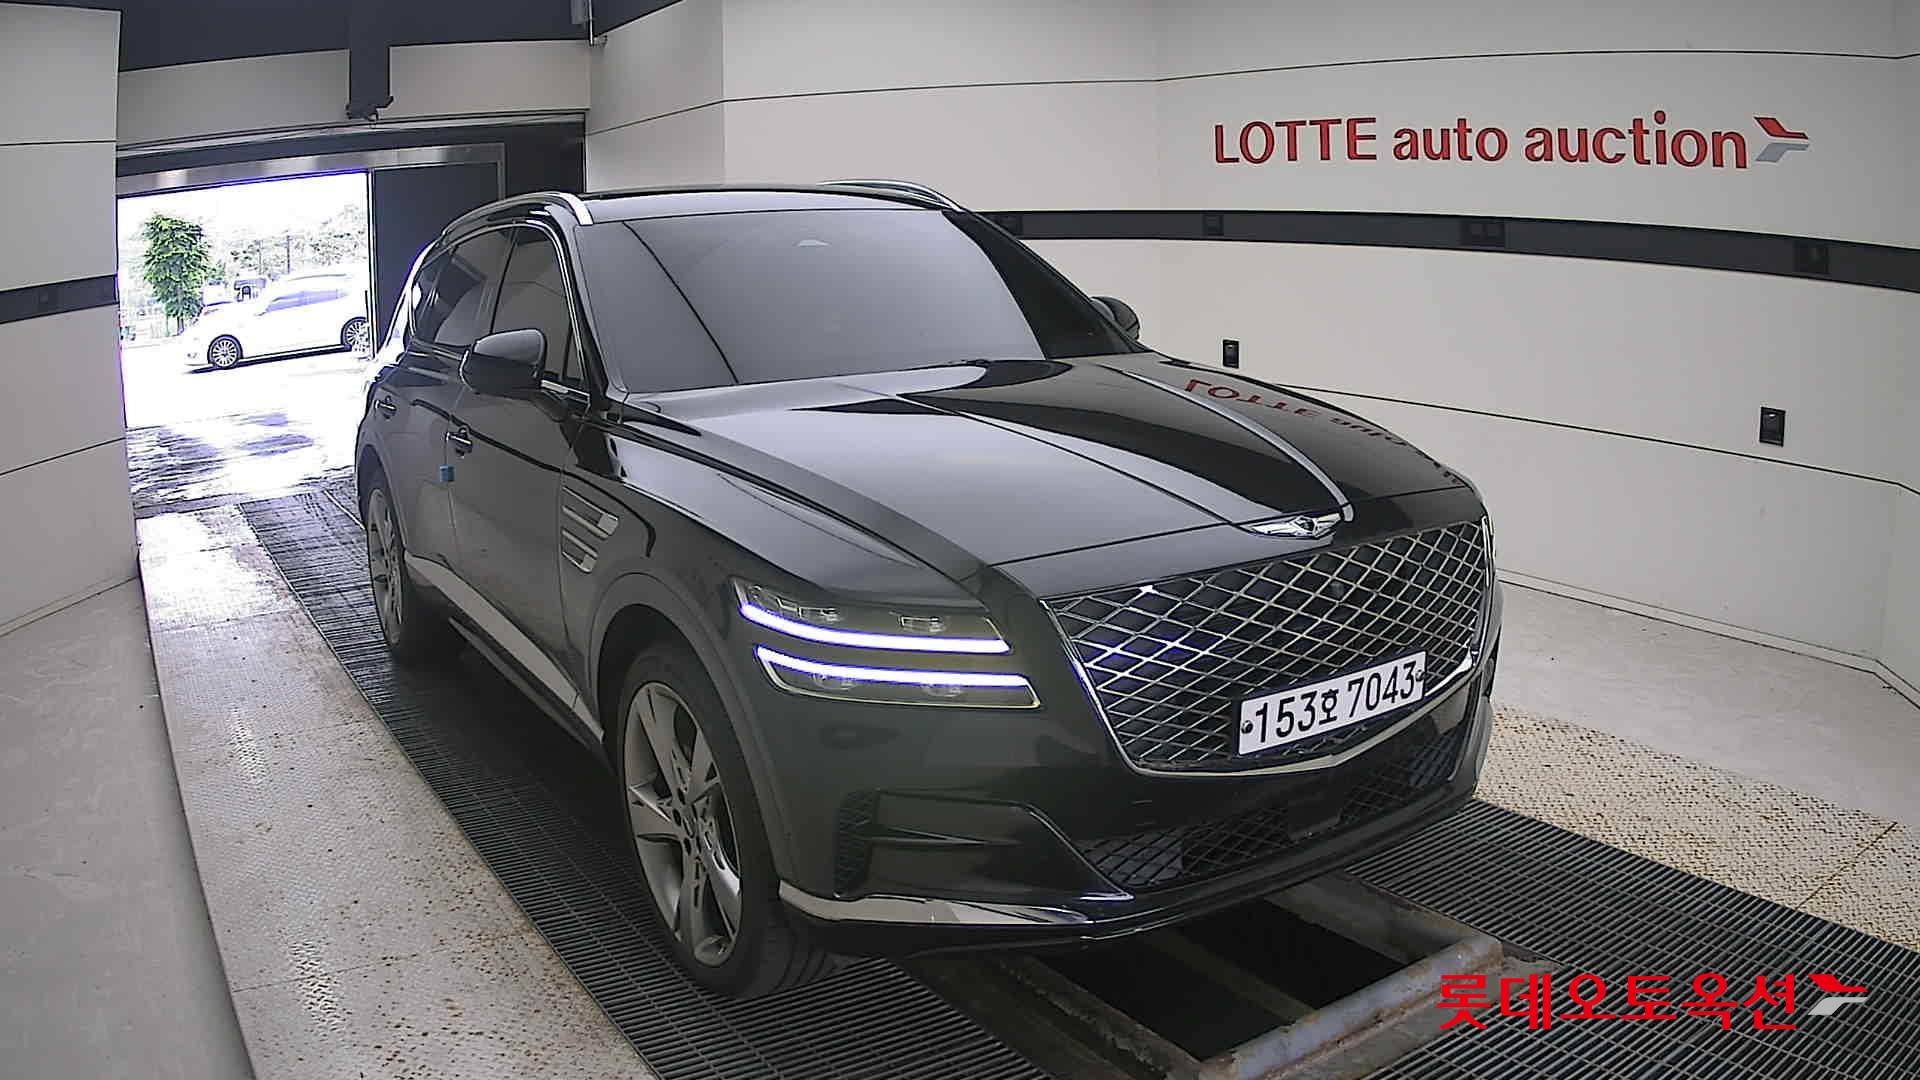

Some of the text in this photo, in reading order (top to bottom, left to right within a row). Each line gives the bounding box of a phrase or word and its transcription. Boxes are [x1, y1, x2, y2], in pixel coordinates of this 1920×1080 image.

[1214, 109, 1748, 169] LOTTE auto auction
[1255, 660, 1417, 743] 153호 7043
